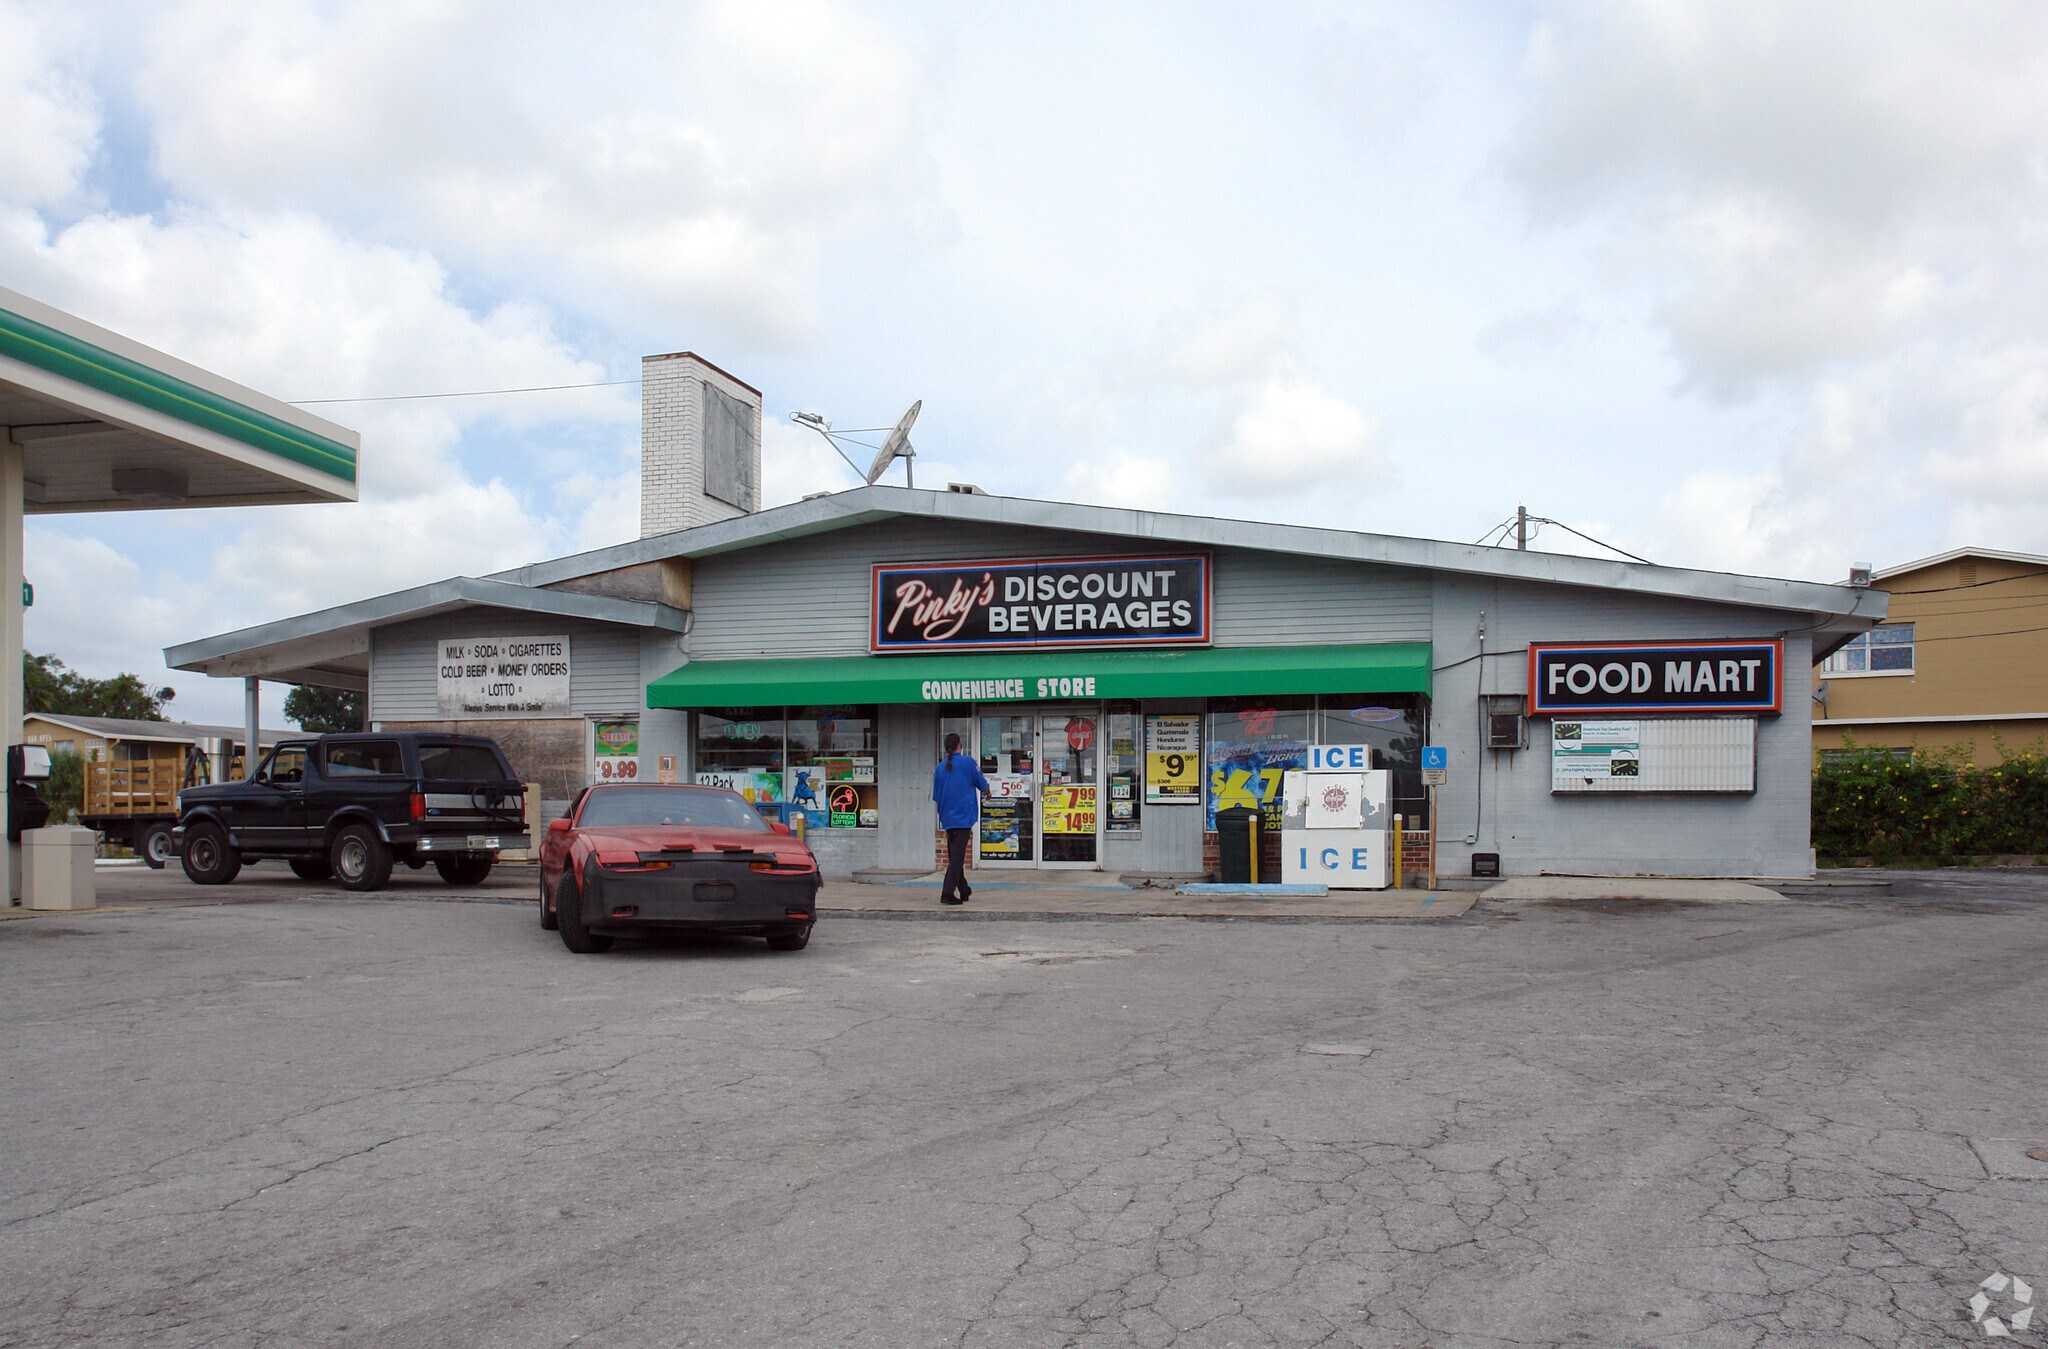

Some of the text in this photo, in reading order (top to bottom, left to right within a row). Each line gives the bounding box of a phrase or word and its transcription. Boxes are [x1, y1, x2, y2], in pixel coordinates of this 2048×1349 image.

[1004, 570, 1176, 602] DISCOUNT
[887, 572, 996, 641] Pinky's
[988, 600, 1192, 633] BEVERAGES
[446, 643, 562, 659] MILK SODA CIGARETTES
[441, 663, 568, 678] COLD BEER MONEY ORDERS
[1548, 659, 1761, 695] FOOD MART
[488, 683, 515, 696] LOTTO
[922, 677, 1096, 700] CONVENIENCE STORE
[485, 704, 505, 712] Service
[507, 703, 519, 711] With
[604, 732, 630, 741] TECATE
[1265, 752, 1302, 765] LIGHT
[1313, 747, 1364, 768] ICE
[596, 760, 638, 779] $9.99
[1299, 847, 1368, 871] ICE
